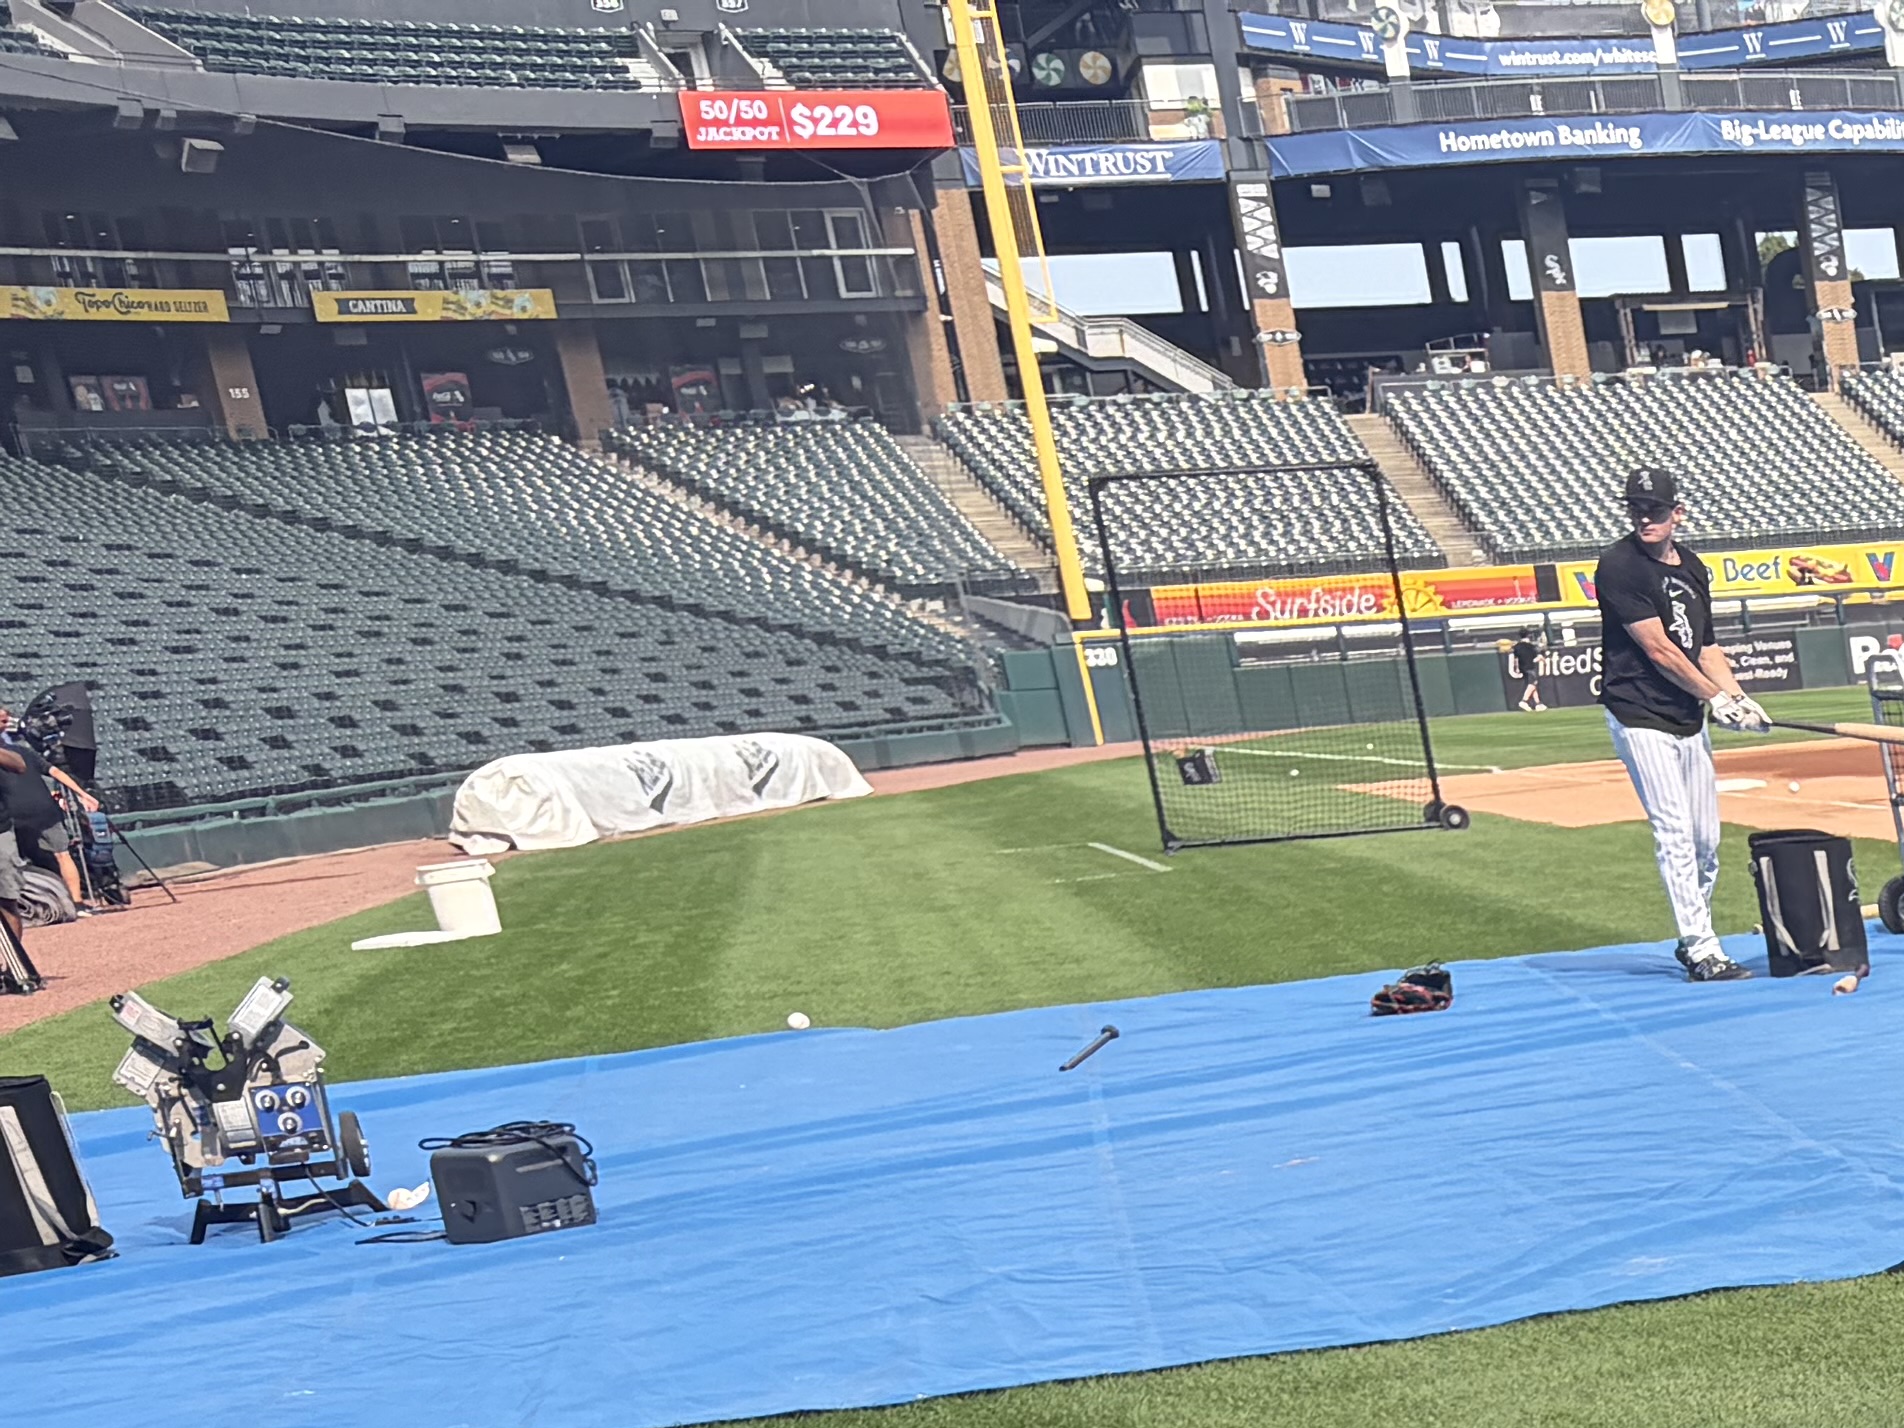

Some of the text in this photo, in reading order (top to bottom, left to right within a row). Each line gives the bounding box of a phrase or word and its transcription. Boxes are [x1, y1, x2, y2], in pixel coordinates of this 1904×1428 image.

[700, 98, 768, 124] 50/50
[790, 102, 880, 140] $229
[696, 125, 780, 141] JACKPOT
[1438, 122, 1643, 153] Hometown Banking
[1720, 119, 1825, 147] Big-League
[1014, 149, 1174, 178] WINTRUST
[348, 300, 407, 314] CANTINA
[1723, 556, 1781, 583] Beef
[1251, 586, 1378, 622] Surfside
